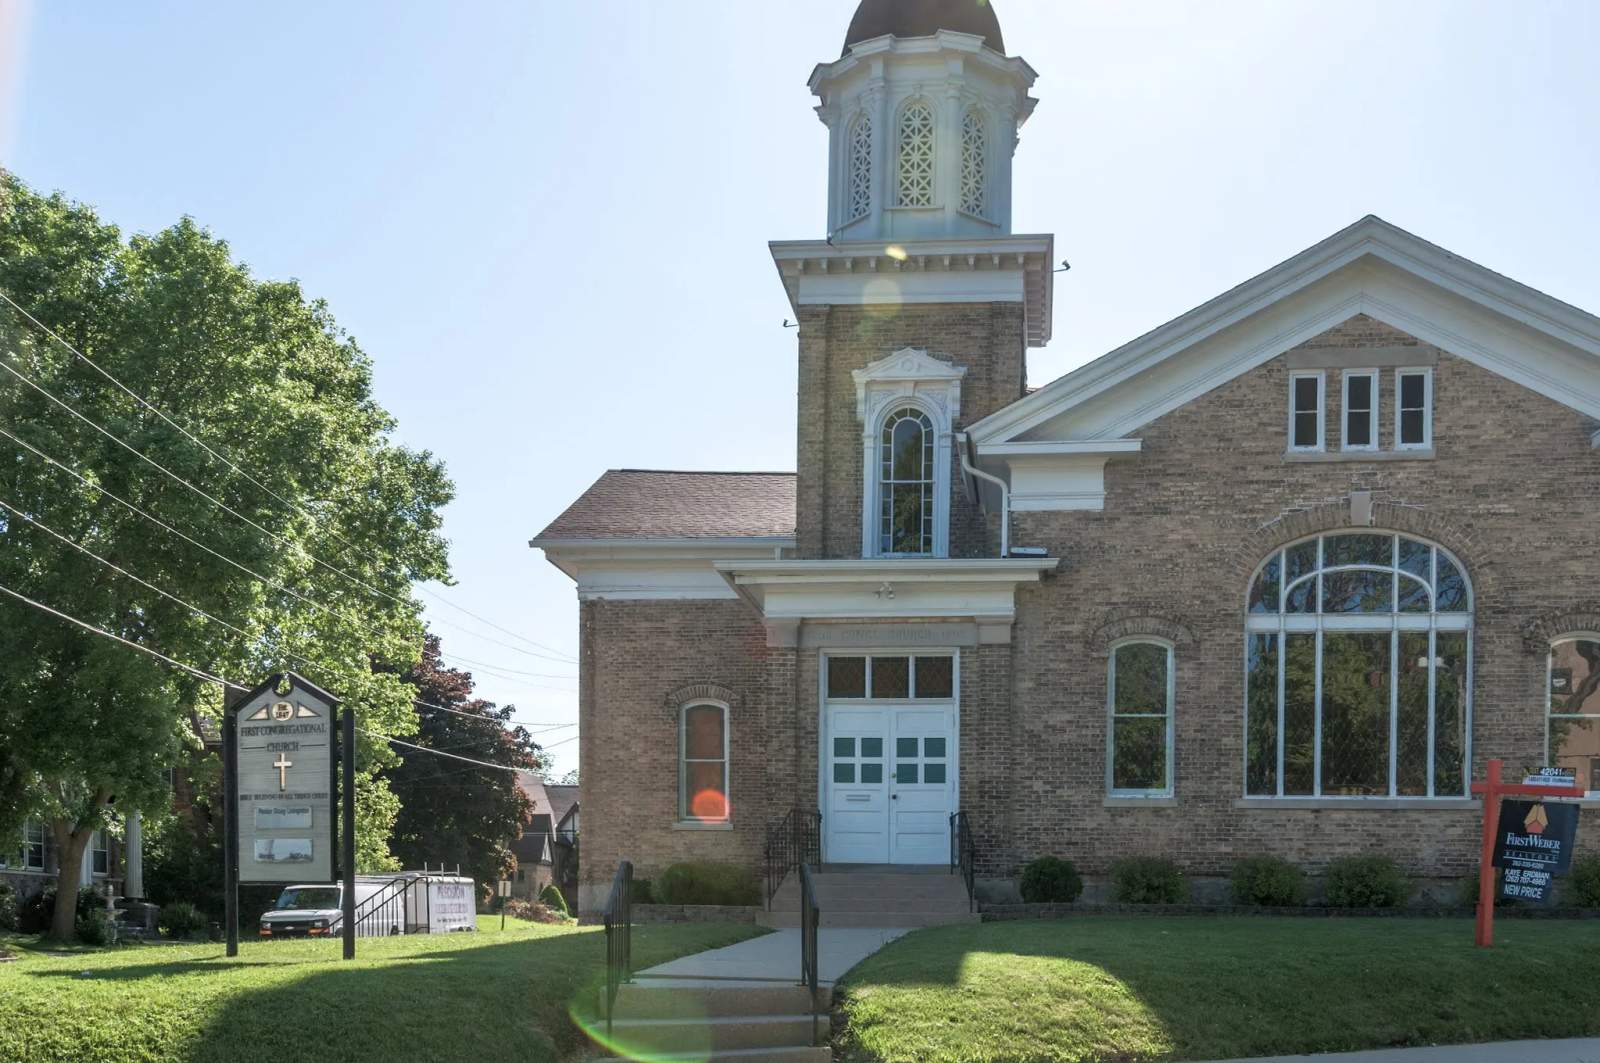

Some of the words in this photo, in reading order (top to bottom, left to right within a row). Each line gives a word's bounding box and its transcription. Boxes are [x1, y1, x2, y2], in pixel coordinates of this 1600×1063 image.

[241, 726, 259, 737] FIRST
[260, 723, 327, 736] CONGREGATIONAL
[266, 742, 299, 752] CHURCH
[1504, 884, 1520, 896] NEW
[1520, 885, 1543, 899] PRICE
